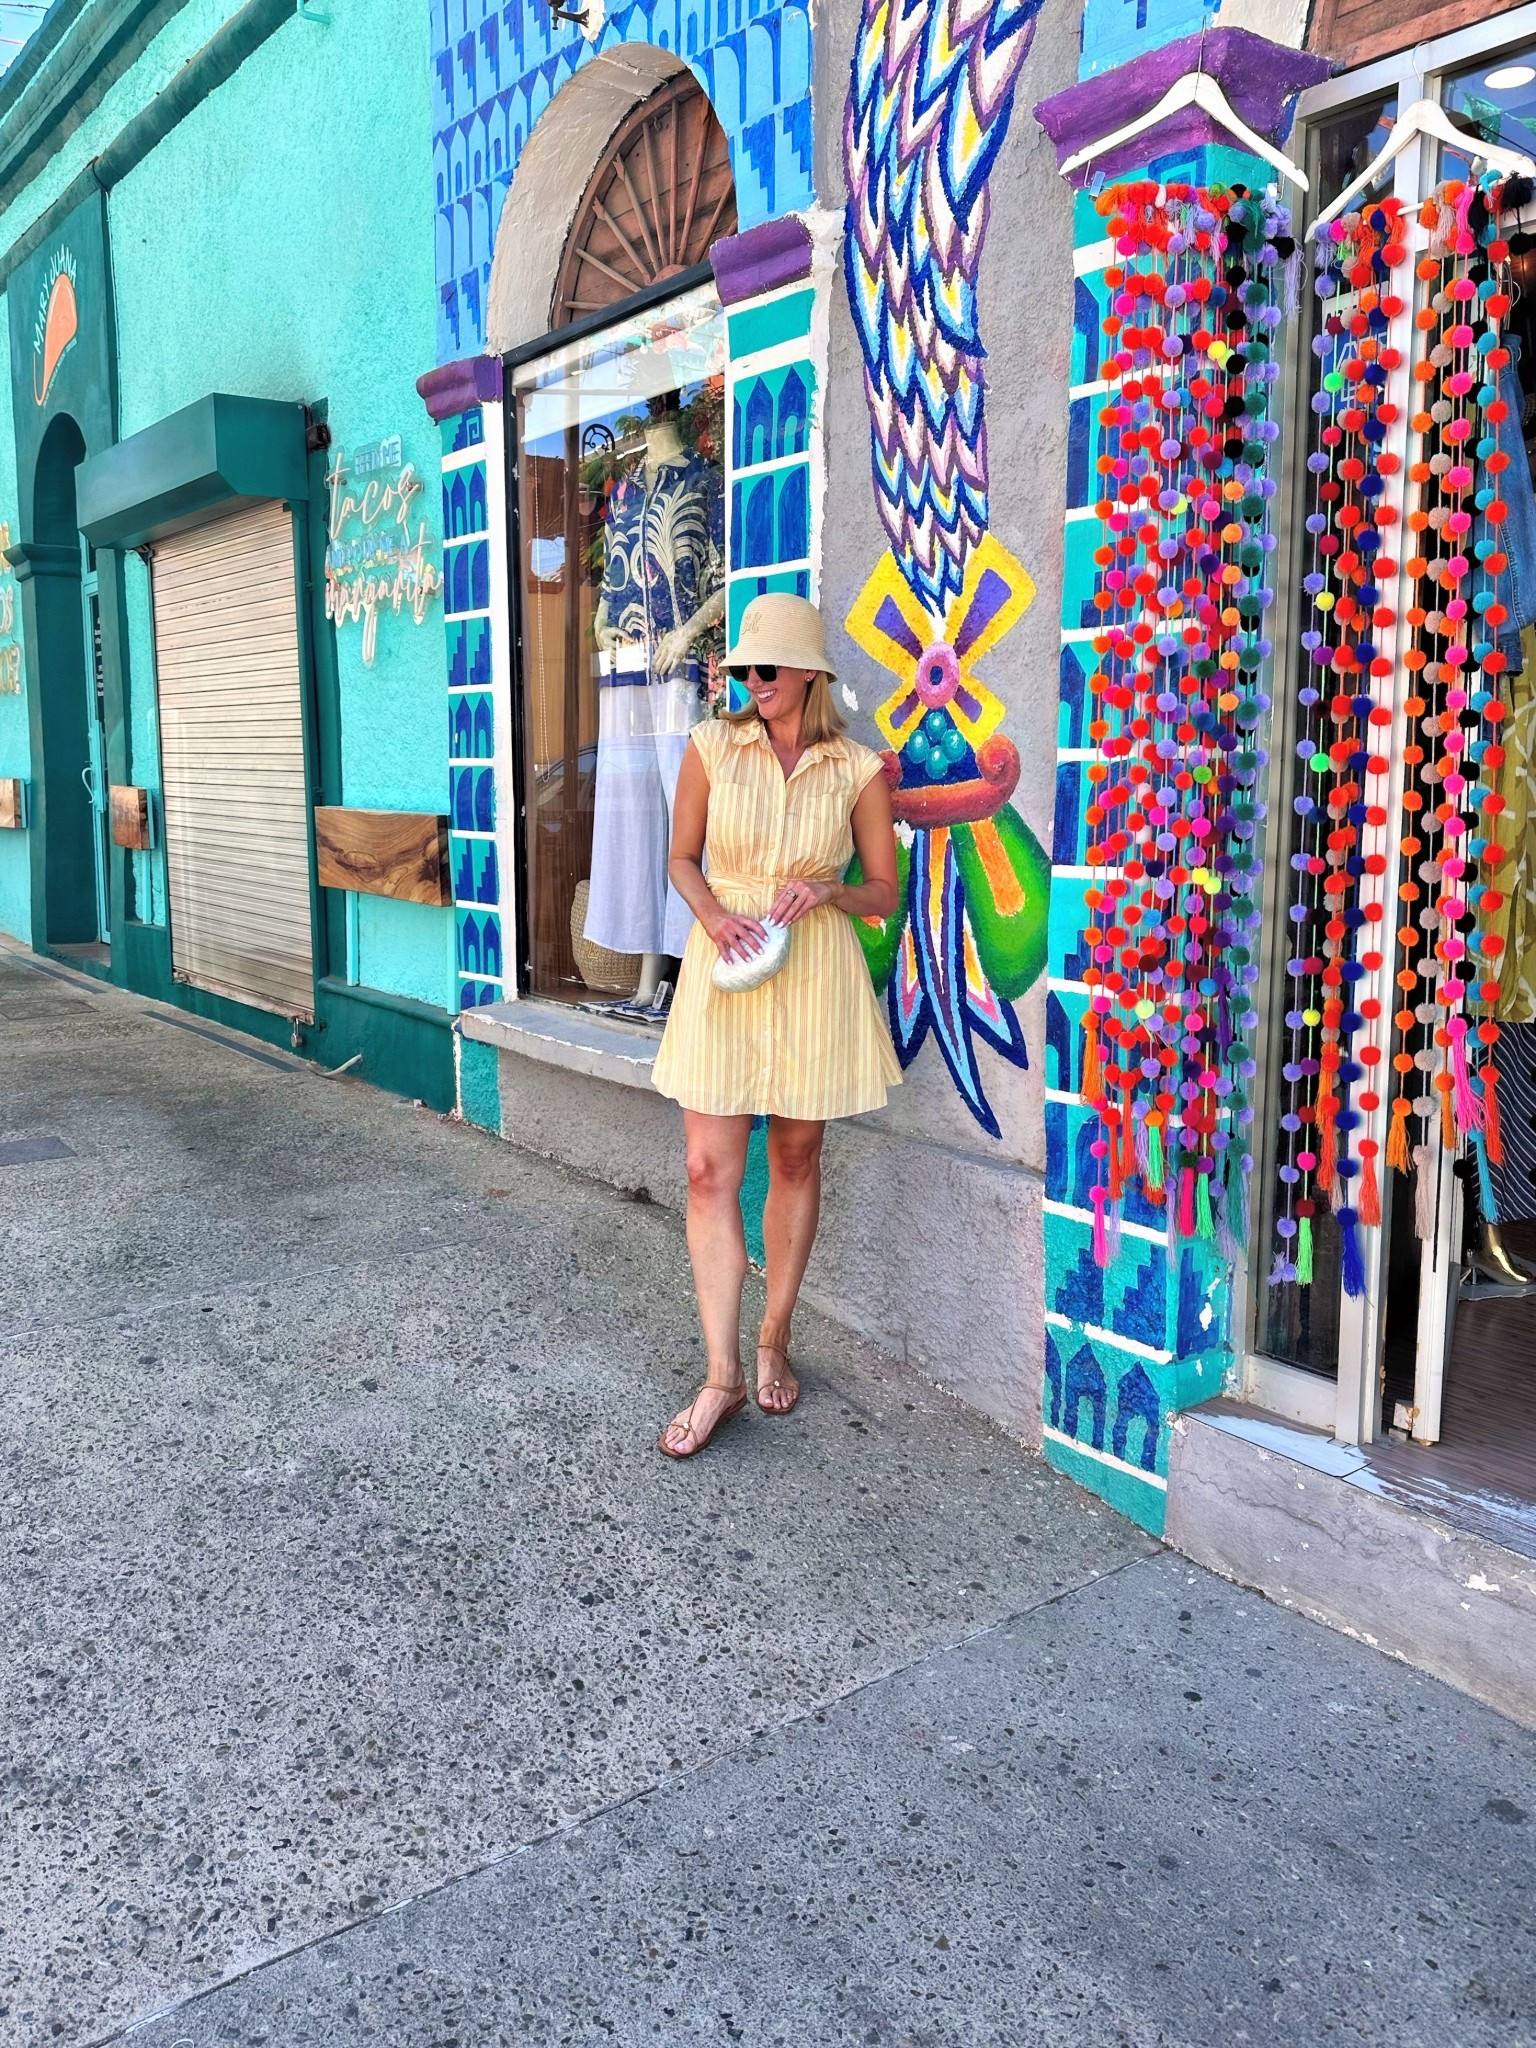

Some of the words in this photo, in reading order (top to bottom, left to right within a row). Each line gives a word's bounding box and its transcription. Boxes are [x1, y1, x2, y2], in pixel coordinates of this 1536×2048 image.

[33, 273, 50, 354] MARY
[50, 243, 77, 288] JUANA
[381, 441, 400, 467] ME
